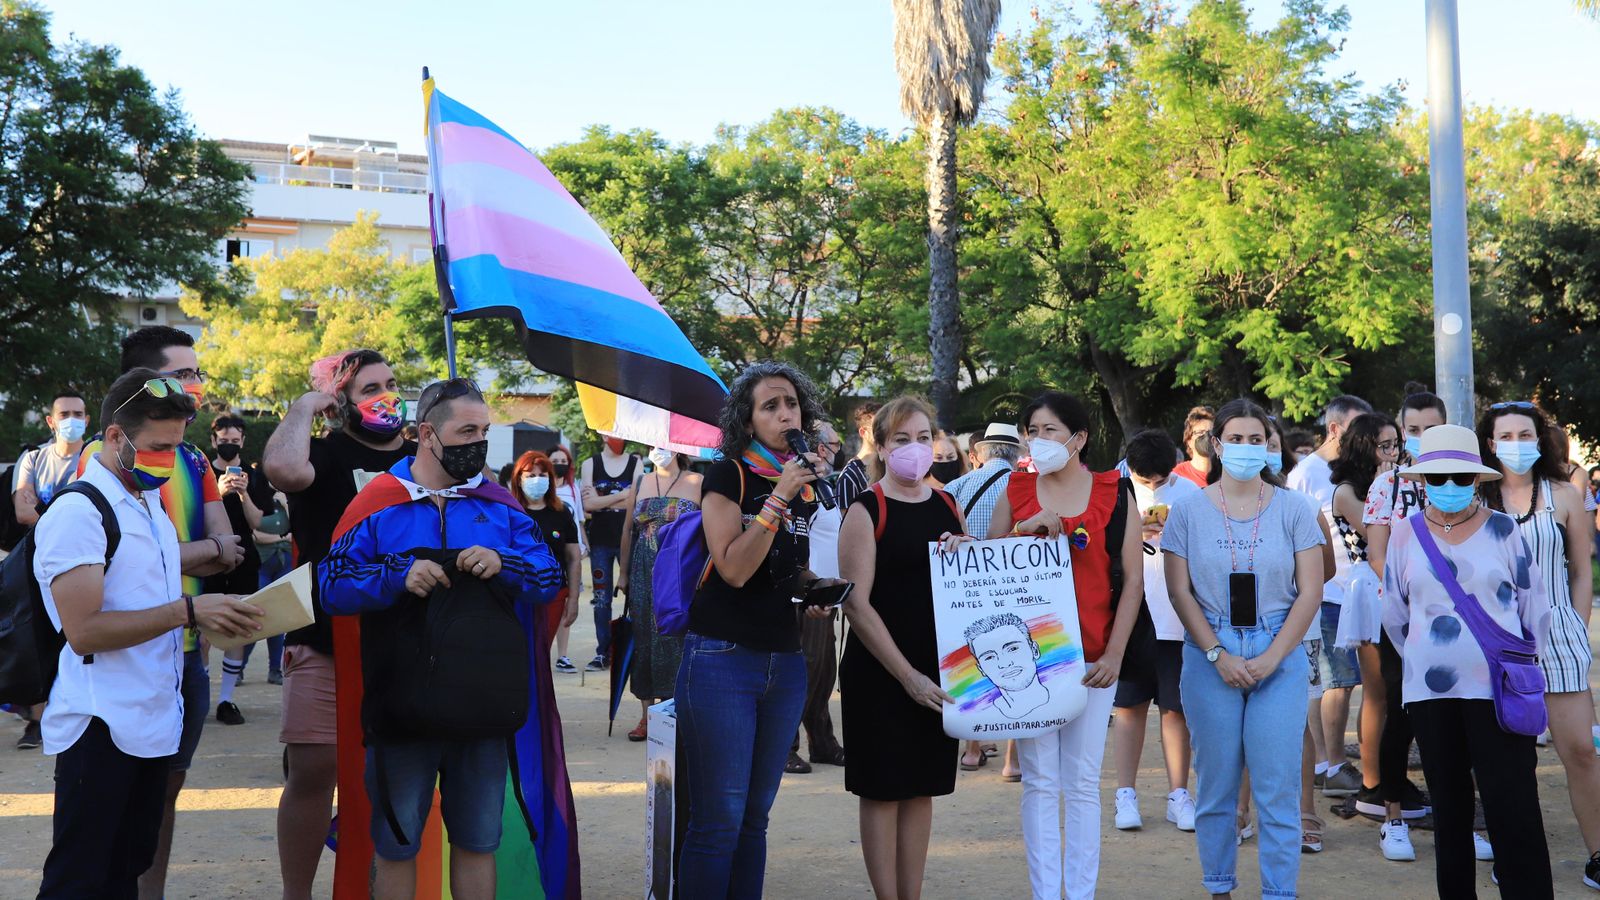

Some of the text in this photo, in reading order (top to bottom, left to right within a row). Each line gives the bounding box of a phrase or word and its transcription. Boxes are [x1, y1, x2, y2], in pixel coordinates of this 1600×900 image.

[944, 571, 1062, 589] NO DEBERÍA SER LO ÚLTIMO
[965, 586, 1028, 598] QUE ESCUCHAS
[950, 595, 1046, 609] ANTES DE MORIR
